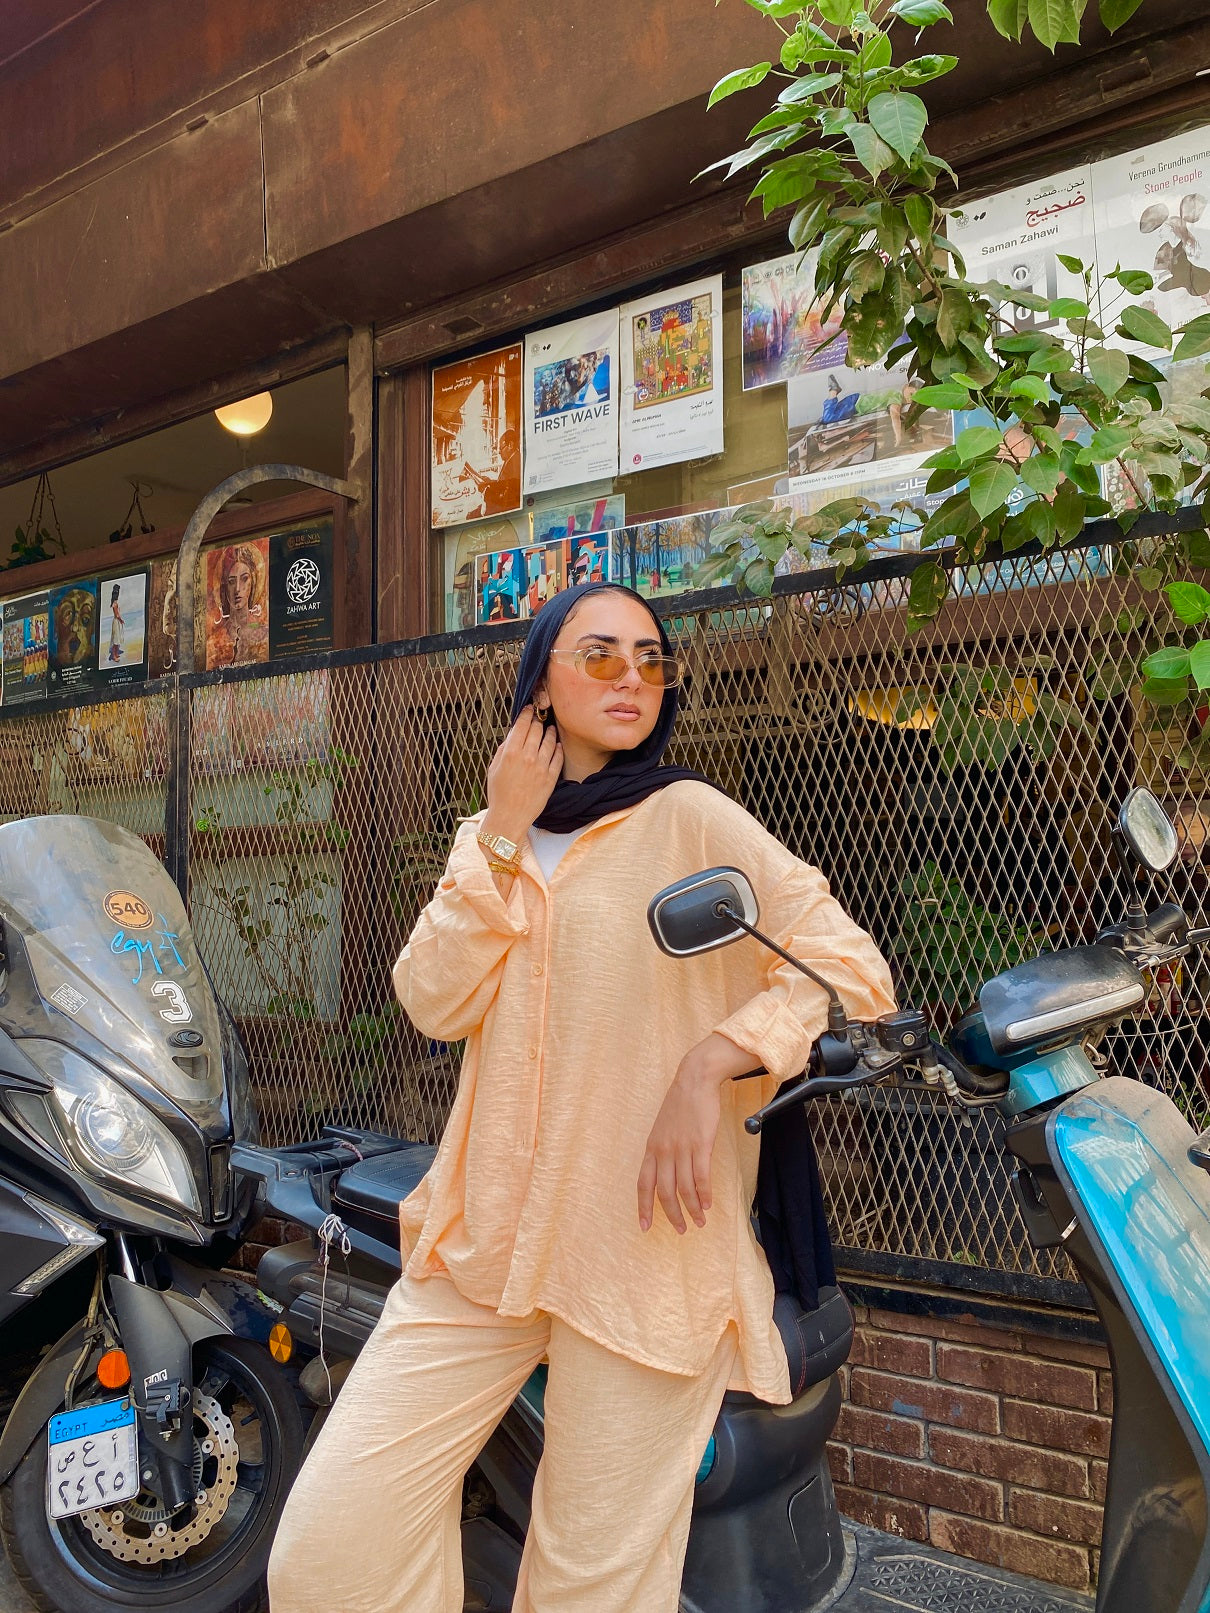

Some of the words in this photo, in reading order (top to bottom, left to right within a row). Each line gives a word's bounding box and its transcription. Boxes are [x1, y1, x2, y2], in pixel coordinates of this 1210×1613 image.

[1128, 167, 1156, 182] Verena
[1144, 180, 1170, 195] Stone
[1172, 168, 1203, 186] People
[1026, 190, 1086, 228] ضجيج
[981, 239, 1018, 256] Saman
[1020, 225, 1059, 245] Zahawi
[534, 415, 568, 434] FIRST
[571, 404, 610, 425] WAVE
[286, 603, 308, 615] ZAHWA
[308, 601, 321, 611] ART
[110, 902, 148, 916] 540
[150, 980, 193, 1024] 3
[55, 1422, 87, 1440] EGYPT
[100, 1412, 130, 1428] مصر
